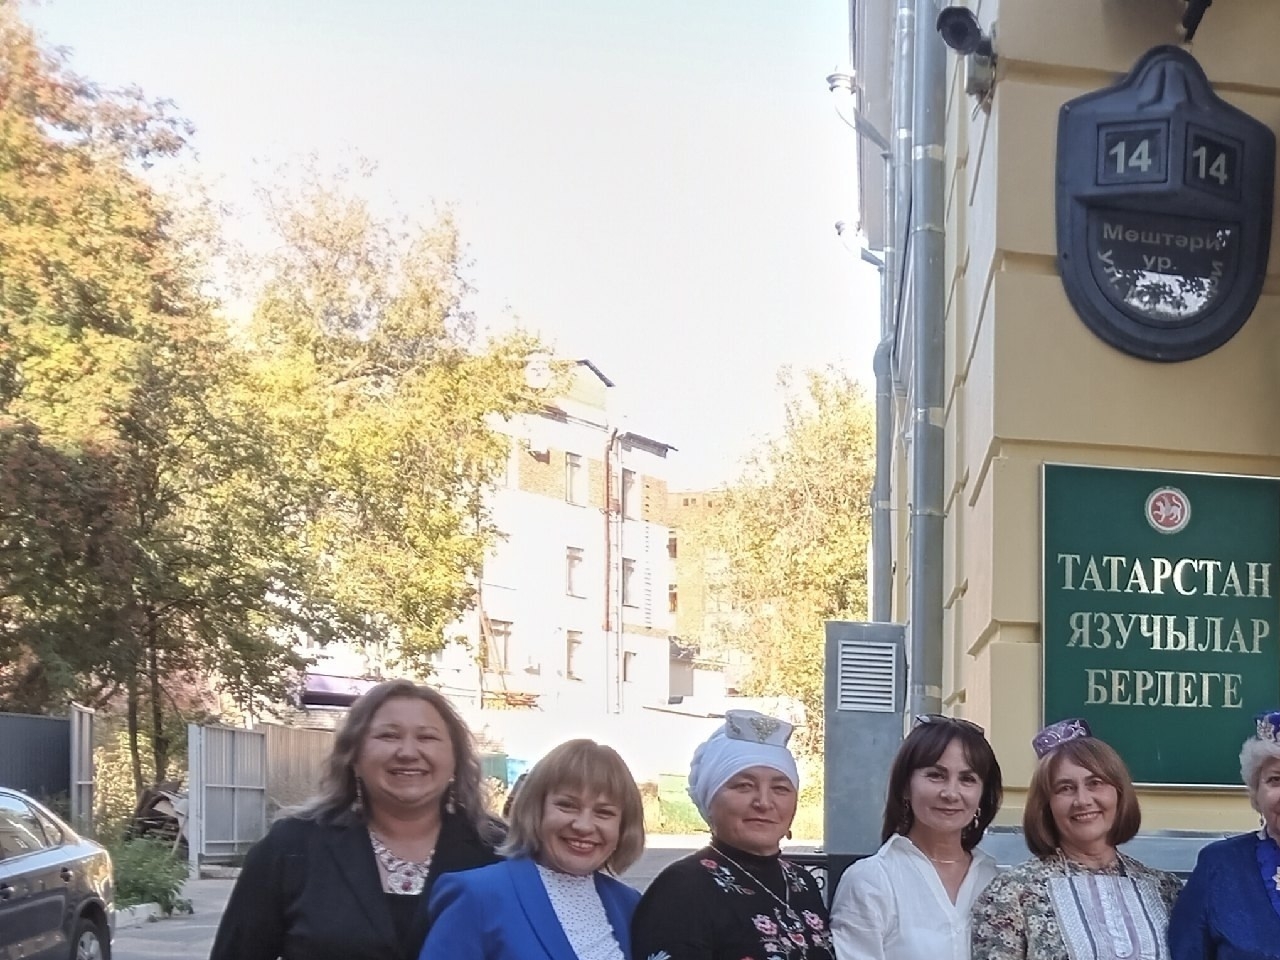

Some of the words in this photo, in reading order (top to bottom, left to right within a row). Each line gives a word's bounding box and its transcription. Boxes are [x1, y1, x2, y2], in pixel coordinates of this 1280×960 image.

[1109, 139, 1151, 174] 14
[1192, 146, 1228, 185] 14
[1057, 552, 1272, 598] ТАТАРСТАН
[1066, 611, 1270, 654] ЯЗУЧЫЛАР
[1084, 668, 1243, 709] БЕРЛЕГЕ
